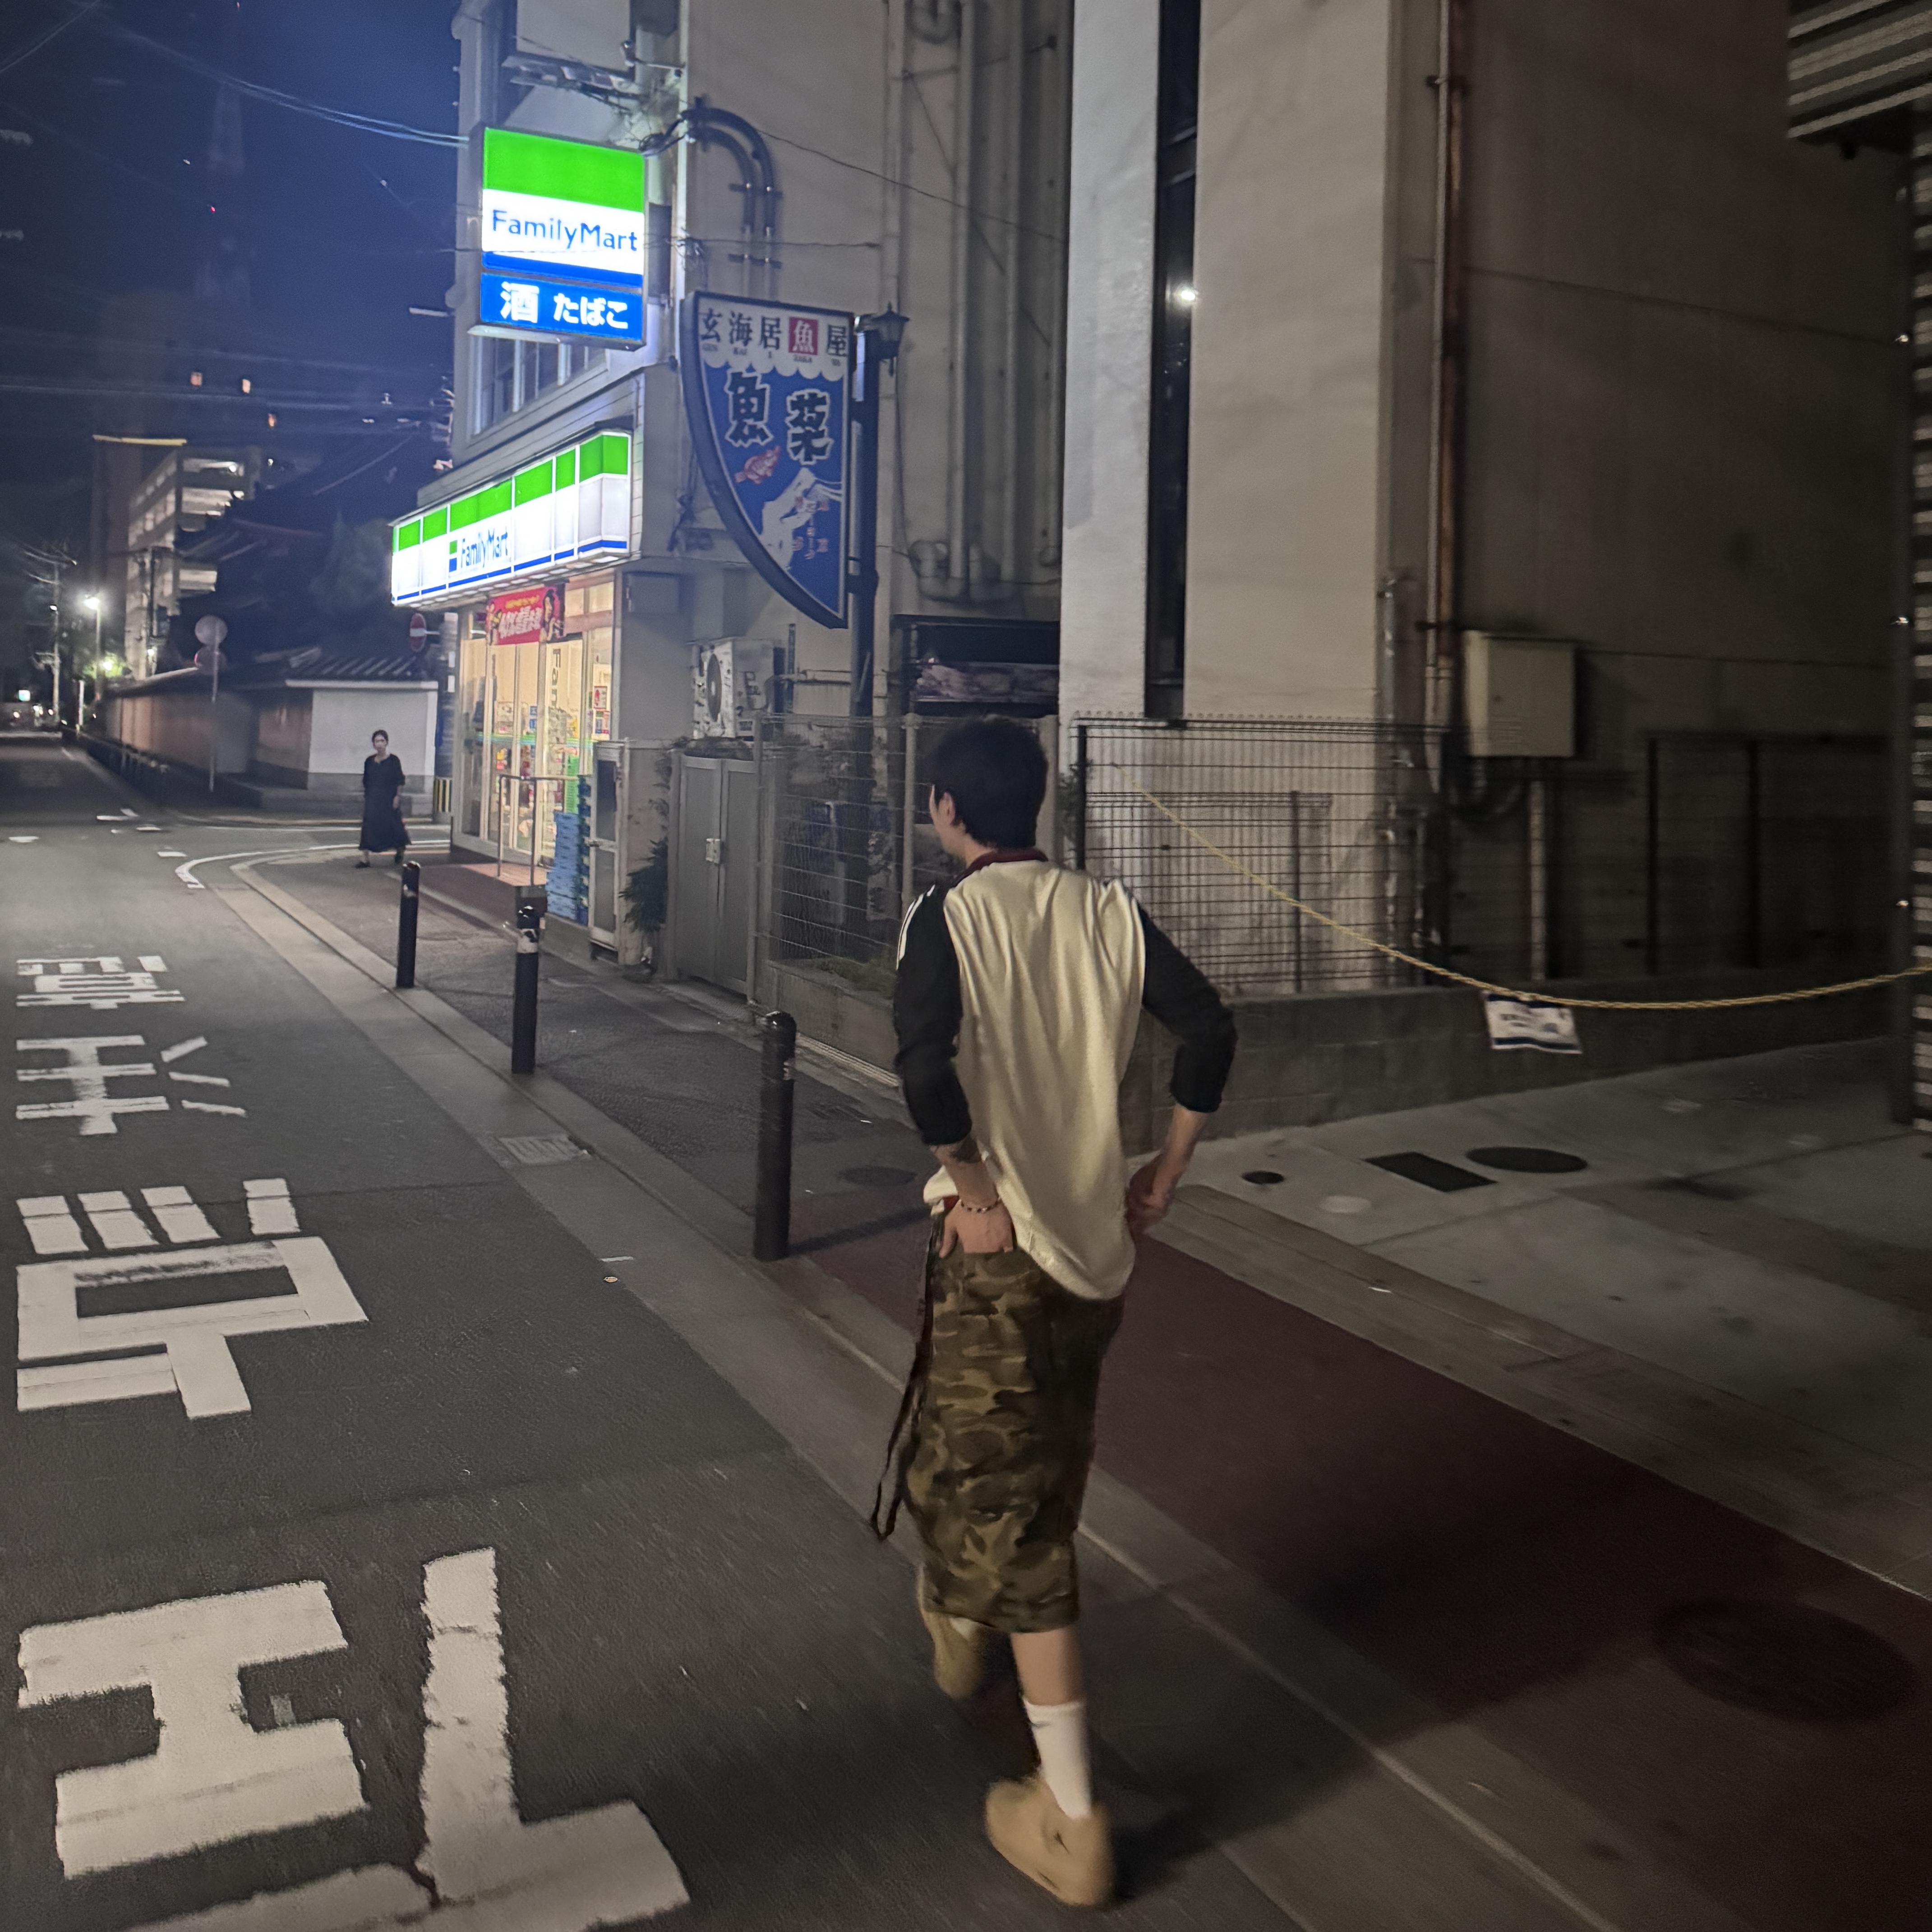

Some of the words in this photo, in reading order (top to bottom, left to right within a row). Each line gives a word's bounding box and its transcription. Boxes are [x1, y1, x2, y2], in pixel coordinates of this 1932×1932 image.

[493, 209, 637, 251] FamilyMart
[500, 281, 539, 323] 酒
[553, 293, 628, 329] たばこ
[699, 308, 848, 357] 玄海居魚屋
[461, 527, 508, 568] FamilyMart
